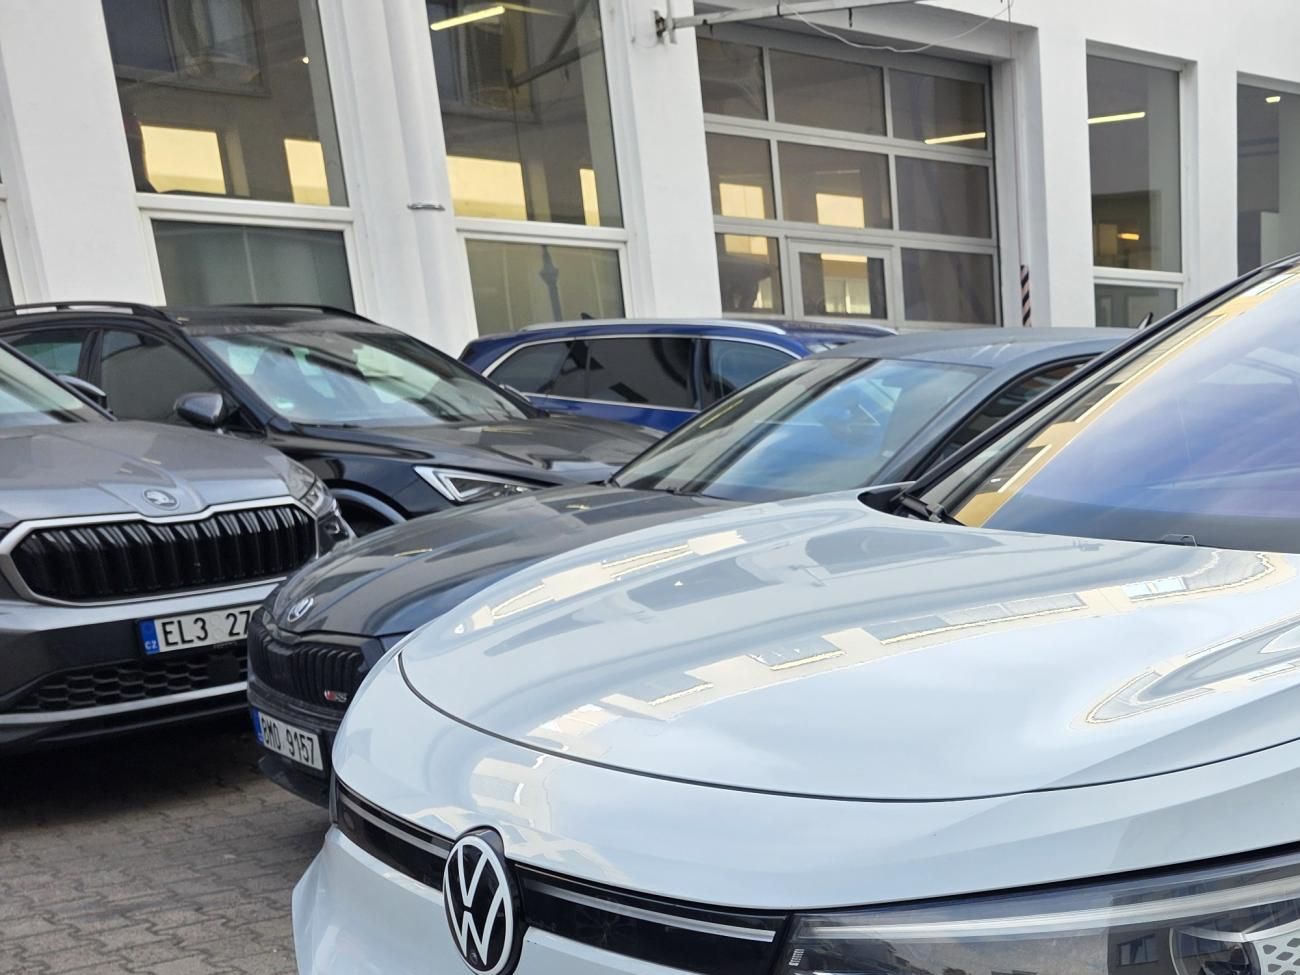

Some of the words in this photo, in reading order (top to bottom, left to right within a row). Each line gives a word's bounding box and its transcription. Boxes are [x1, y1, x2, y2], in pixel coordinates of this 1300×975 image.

[144, 640, 158, 650] CZ
[161, 618, 208, 647] EL3
[286, 728, 315, 765] 9157
